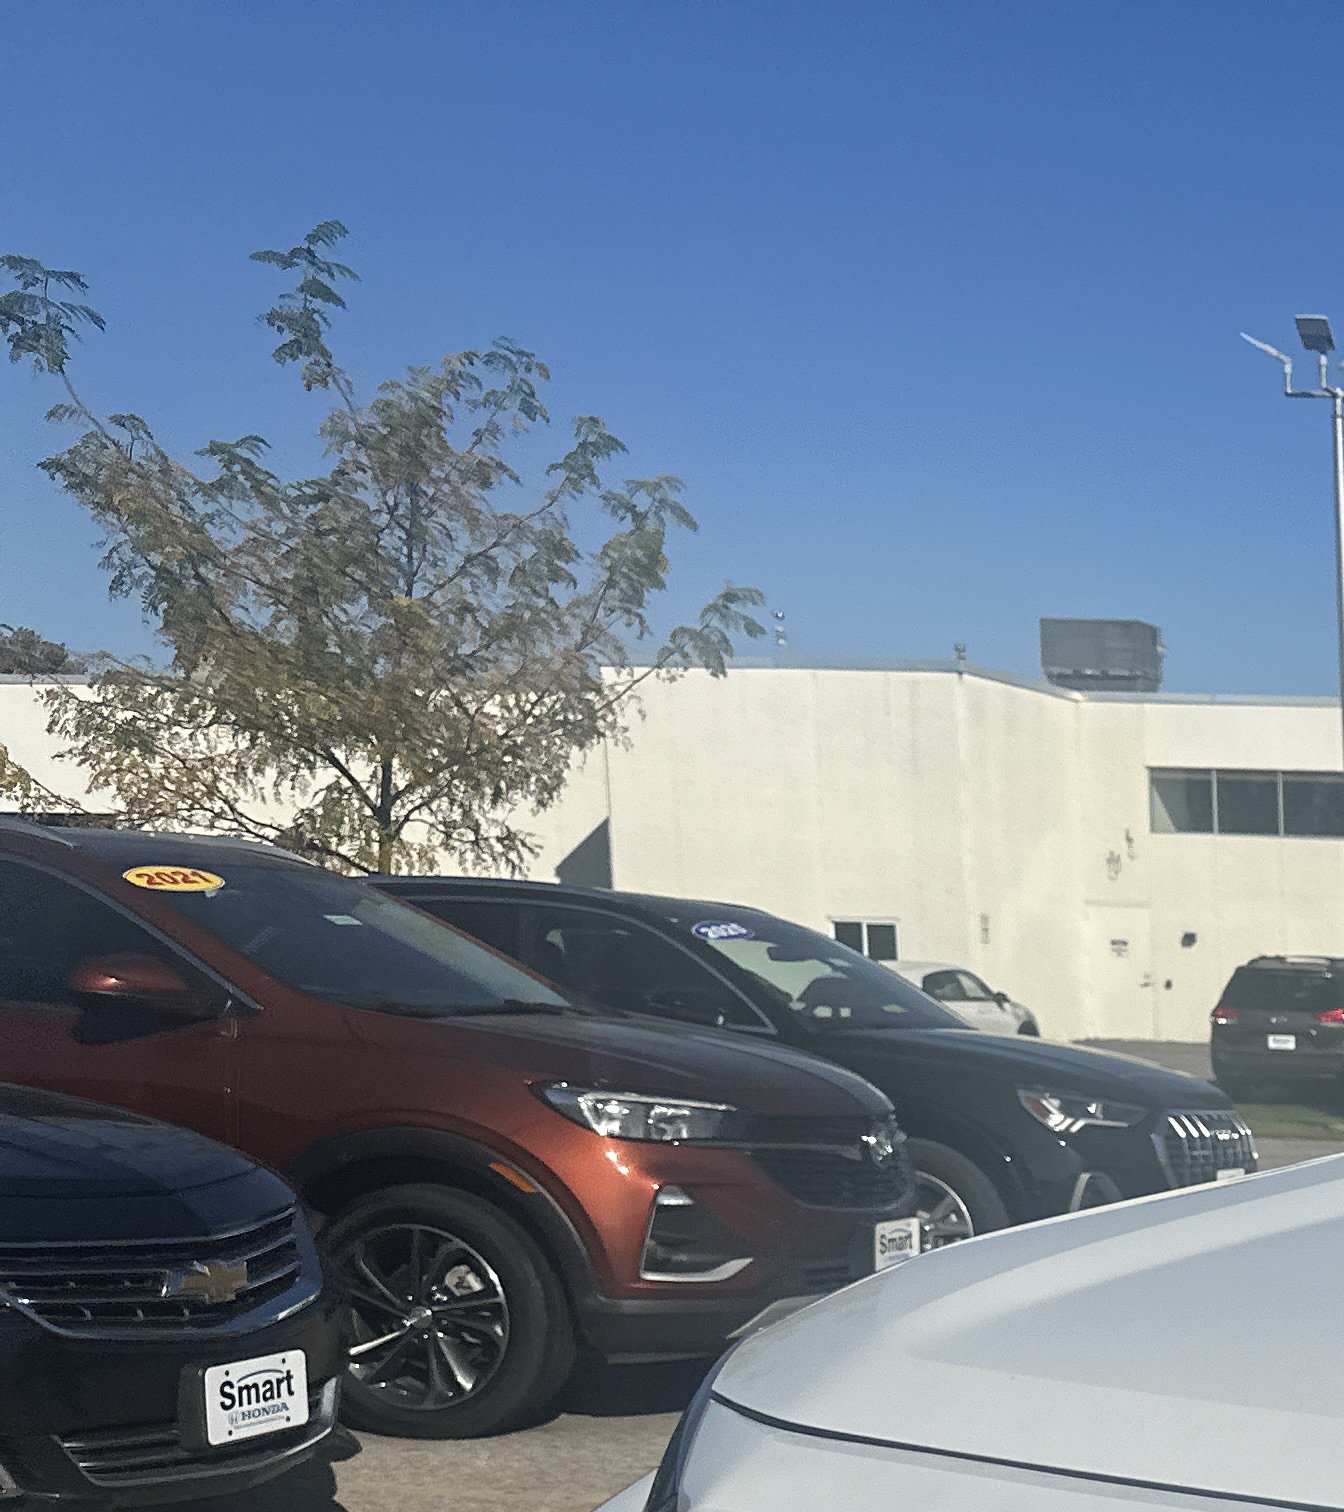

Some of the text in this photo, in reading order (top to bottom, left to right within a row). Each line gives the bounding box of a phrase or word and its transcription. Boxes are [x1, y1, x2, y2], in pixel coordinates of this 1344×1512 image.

[135, 870, 214, 886] 2021
[219, 1368, 295, 1411] Smart
[241, 1402, 290, 1421] HONDA
